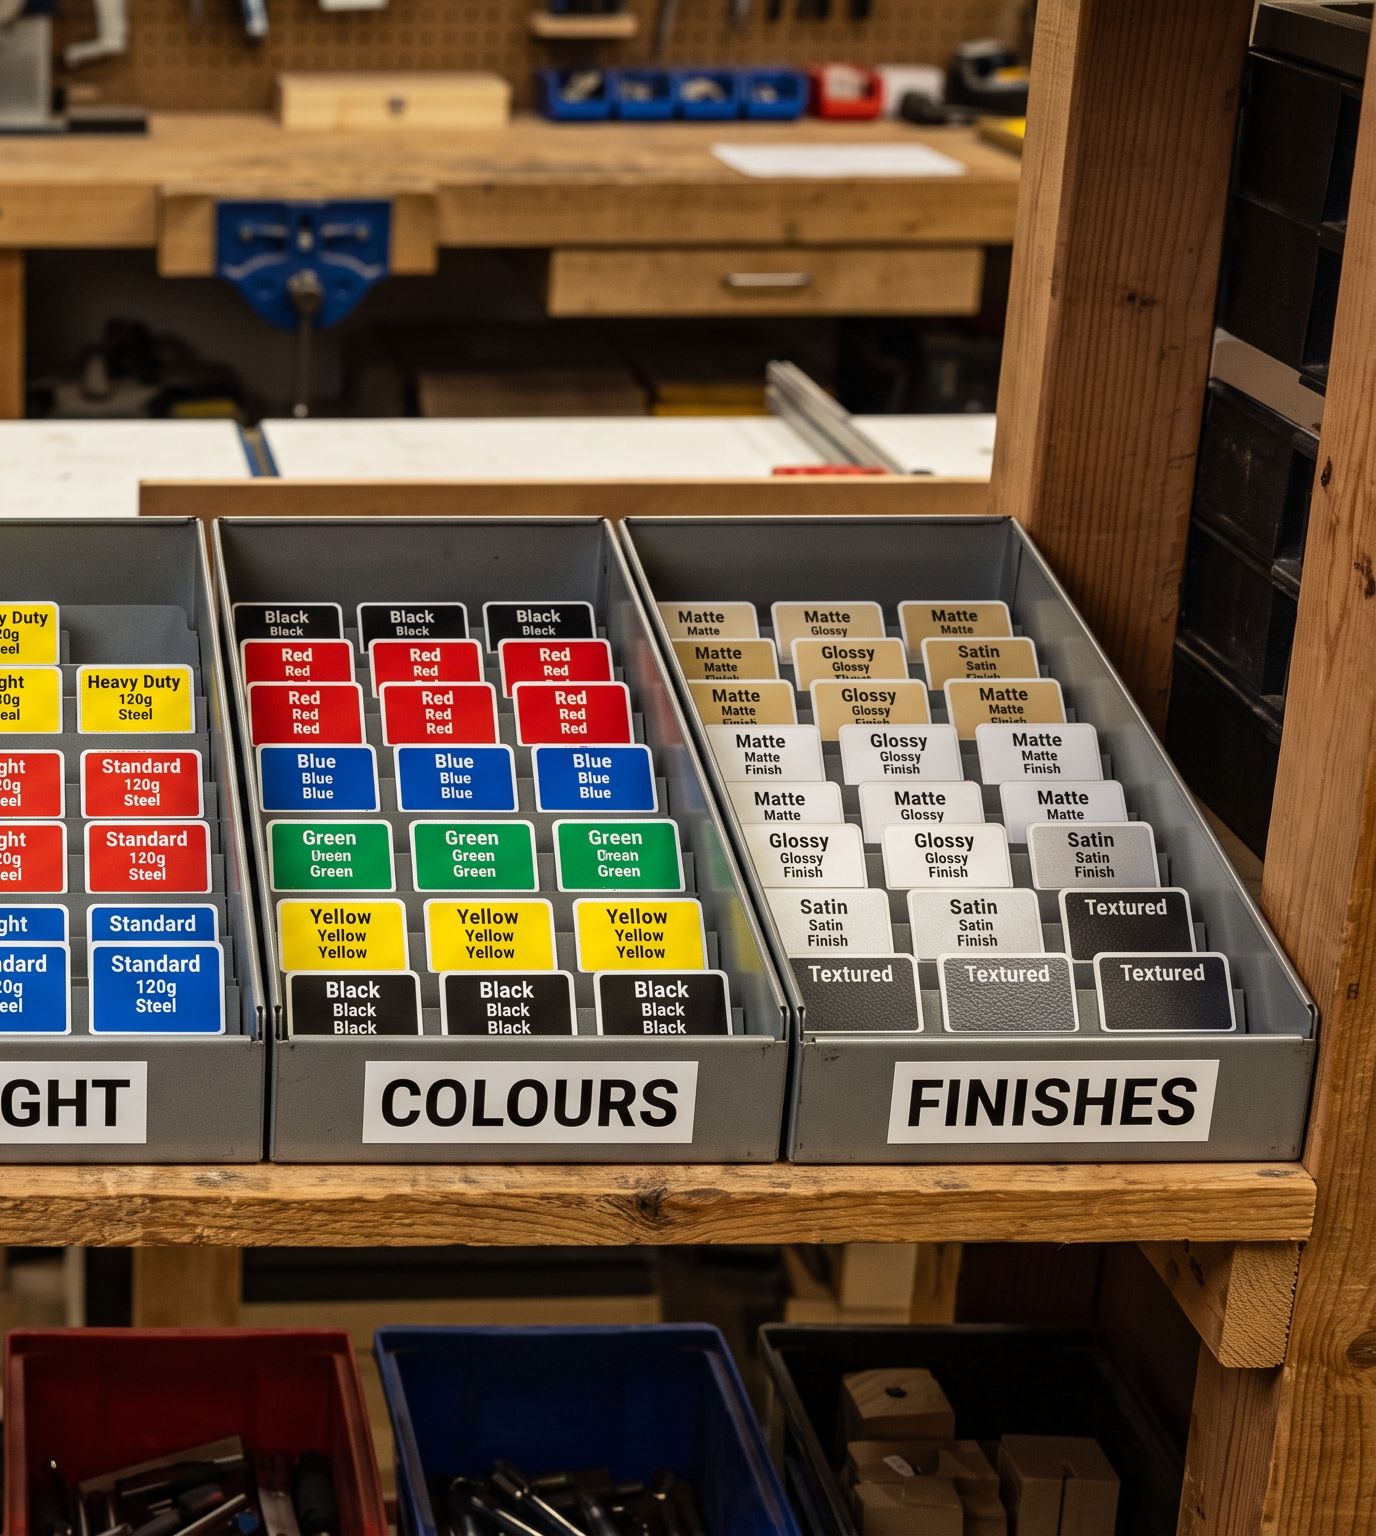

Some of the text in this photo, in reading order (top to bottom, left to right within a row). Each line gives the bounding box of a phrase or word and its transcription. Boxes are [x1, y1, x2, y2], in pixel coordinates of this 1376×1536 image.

[12, 611, 48, 627] Duty
[390, 610, 435, 623] Black
[516, 609, 561, 622] Black
[804, 610, 850, 623] Matte
[931, 609, 978, 622] Matte
[410, 648, 441, 663] Red
[540, 647, 571, 661] Red
[822, 645, 875, 662] Glossy
[958, 645, 1000, 658] Satin
[413, 665, 438, 676] Red
[966, 661, 996, 671] Satin
[422, 690, 454, 705] Red
[555, 690, 587, 705] Red
[841, 688, 896, 706] Glossy
[979, 688, 1028, 701] Matte
[425, 708, 452, 720] Red
[989, 704, 1024, 714] Matte
[426, 722, 453, 734] Red
[870, 733, 927, 751] Glossy
[1012, 733, 1062, 747] Matte
[435, 753, 474, 768] Blue
[573, 753, 612, 768] Blue
[1021, 750, 1058, 761] Matte
[102, 758, 181, 773] Standard
[1024, 763, 1061, 774] Finish
[440, 772, 471, 784] Blue
[441, 786, 472, 799] Blue
[894, 791, 946, 805] Matte
[1037, 790, 1089, 805] Matte
[1047, 809, 1084, 820] Matte
[106, 830, 187, 847] Standard
[445, 830, 499, 845] Green
[588, 830, 642, 845] Green
[915, 832, 974, 852] Glossy
[1068, 832, 1114, 847] Satin
[452, 849, 495, 862] Green
[1075, 852, 1110, 863] Satin
[453, 865, 496, 877] Green
[1075, 865, 1115, 878] Finish
[800, 898, 848, 914] Satin
[950, 898, 998, 915] Satin
[1084, 898, 1167, 915] Textured
[110, 914, 196, 932] Standard
[457, 908, 518, 924] Yellow
[606, 908, 667, 924] Yellow
[465, 929, 514, 942] Yellow
[466, 945, 515, 959] Yellow
[111, 954, 200, 972] Standard
[808, 965, 893, 982] Textured
[964, 964, 1050, 983] Textured
[1120, 964, 1205, 981] Textured
[480, 981, 534, 998] Black
[635, 980, 689, 998] Black
[487, 1002, 530, 1017] Black
[382, 1079, 678, 1127] COLOURS
[908, 1077, 1197, 1127] FINISHES
